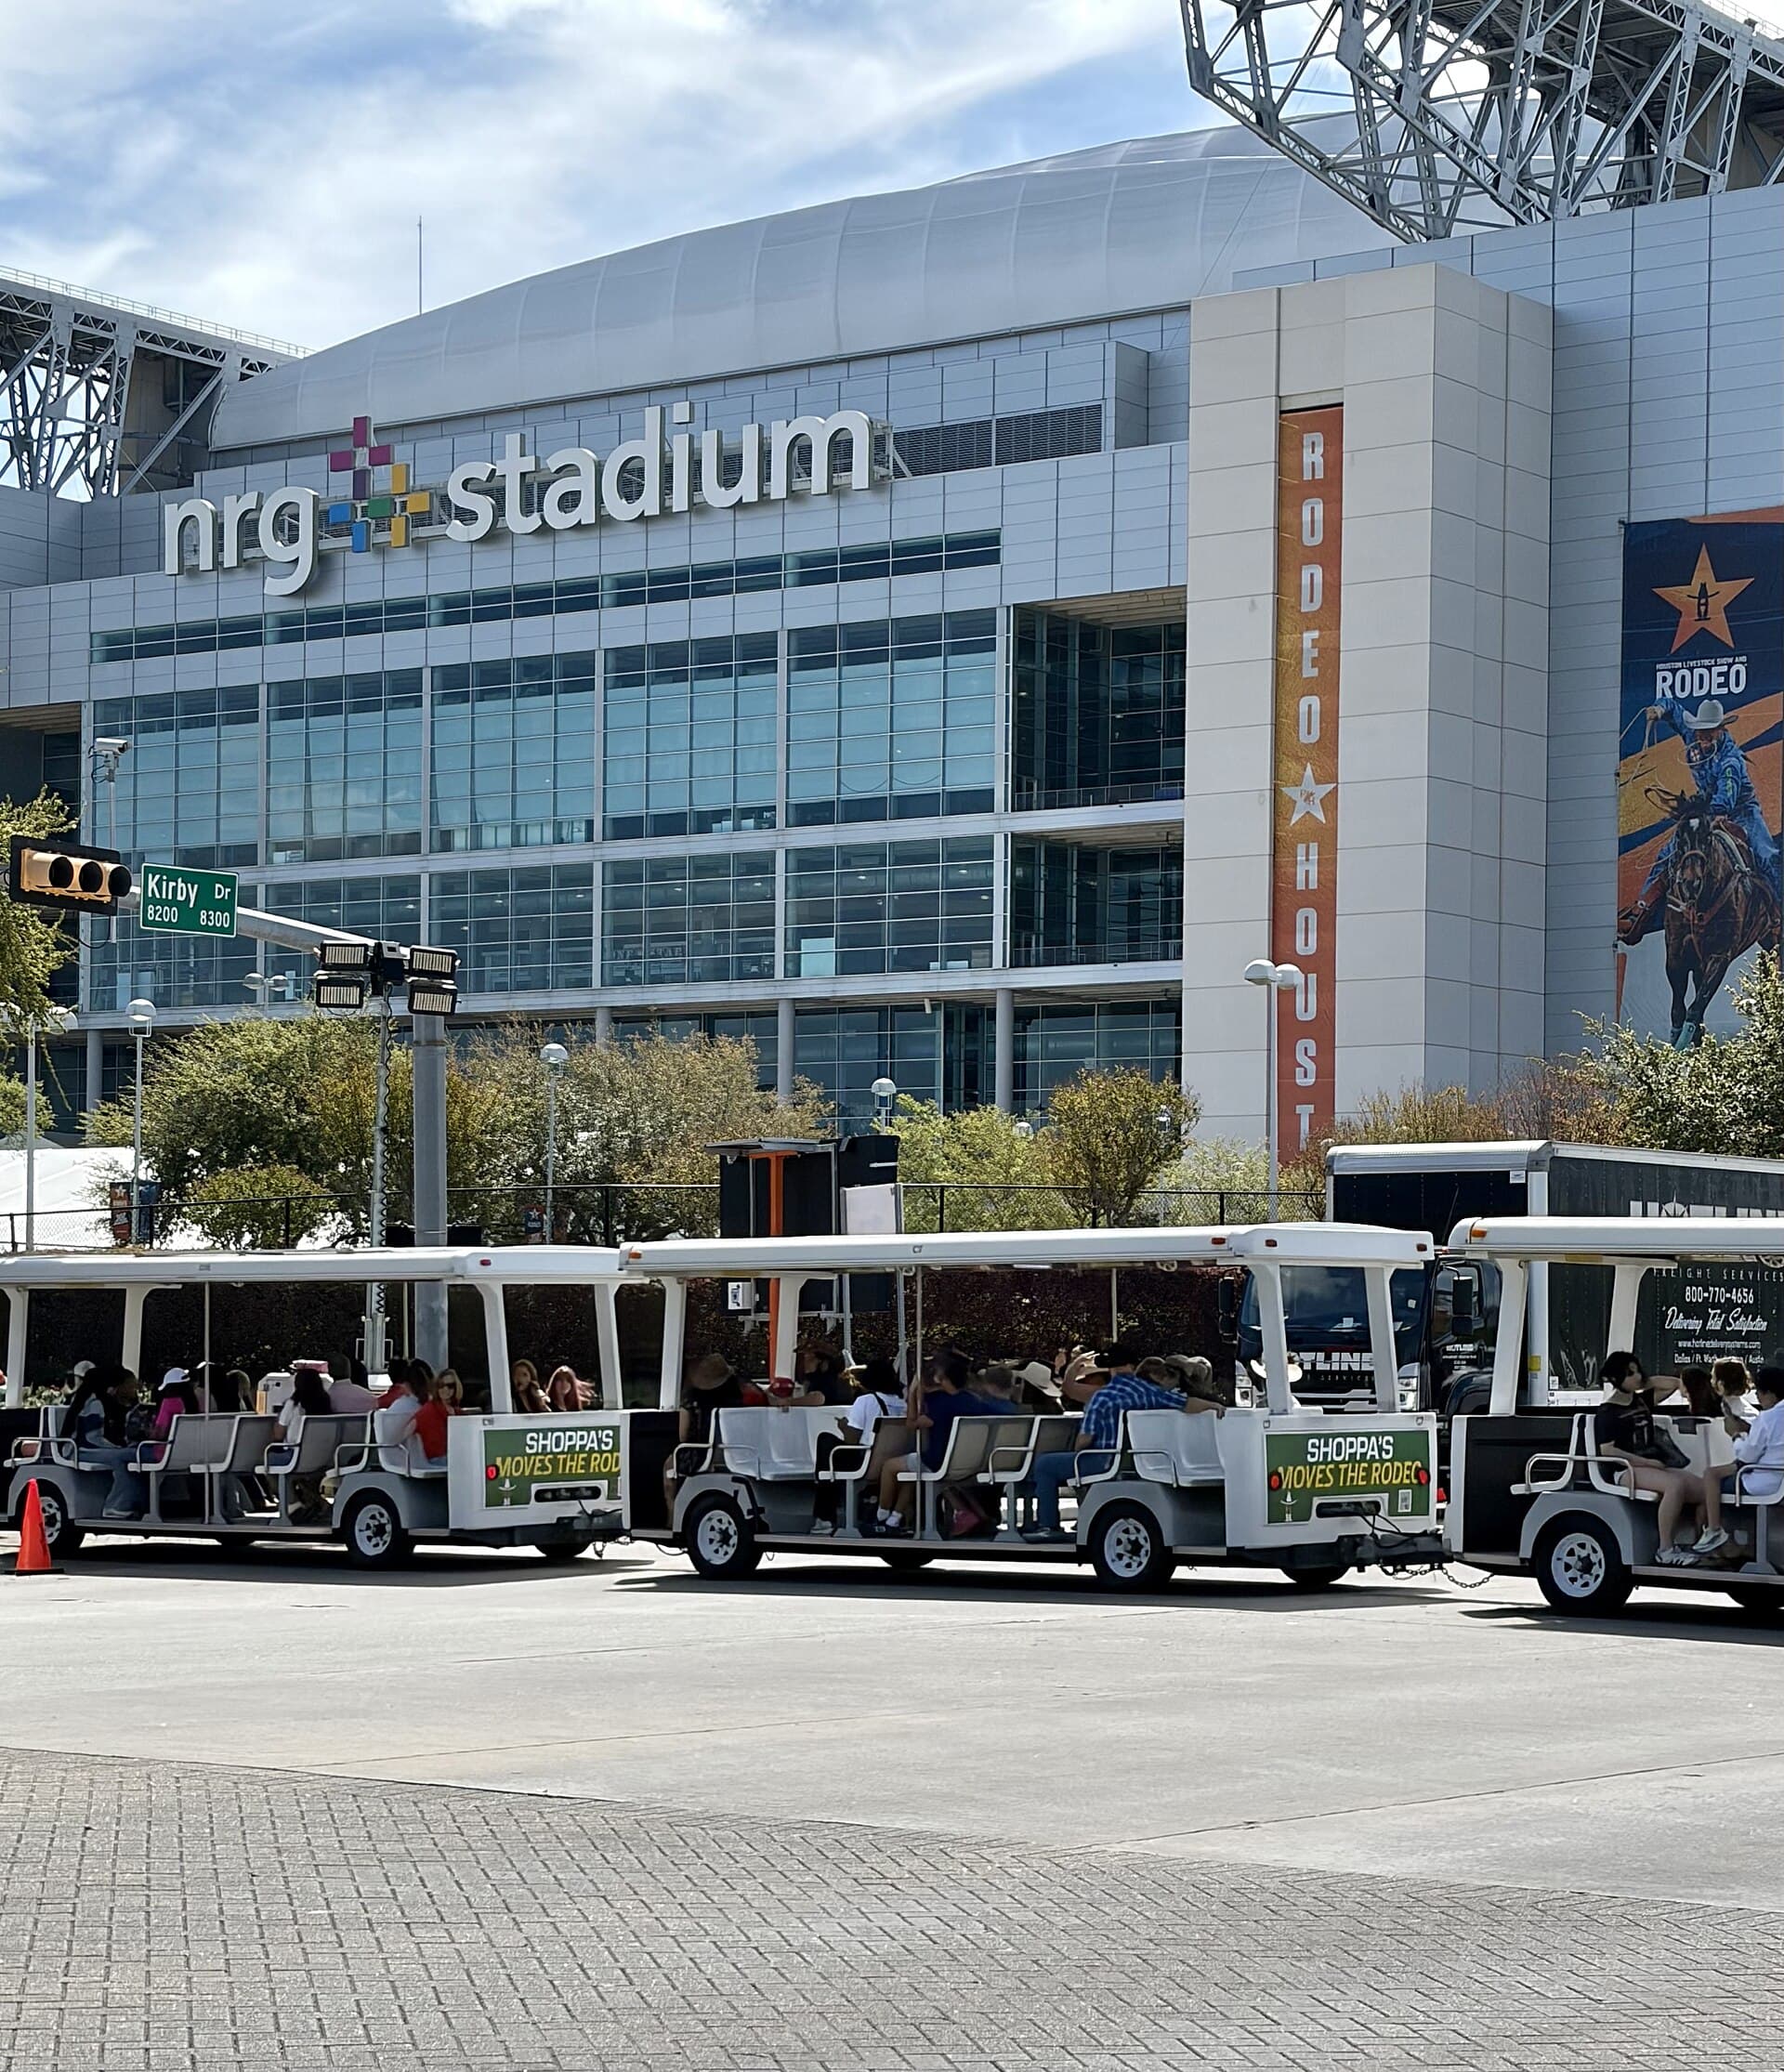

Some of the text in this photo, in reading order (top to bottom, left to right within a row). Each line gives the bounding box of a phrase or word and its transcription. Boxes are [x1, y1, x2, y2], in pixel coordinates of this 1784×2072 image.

[164, 400, 875, 596] nrg stadium
[1298, 431, 1324, 744] RODEO
[1683, 658, 1715, 668] LIVESTOCK
[1716, 657, 1734, 665] SHOW
[1656, 665, 1747, 699] RODEO
[148, 873, 230, 908] Kirby Dr
[148, 905, 230, 927] 8200 8300
[1723, 1269, 1784, 1282] SERVICES
[1685, 1286, 1754, 1304] 800-770-4656
[525, 1430, 613, 1453] SHOPPA'S
[1306, 1436, 1394, 1462] SHOPPA'S
[496, 1454, 553, 1477] MOVES
[558, 1453, 587, 1475] THE
[1278, 1464, 1334, 1489] MOVES
[1338, 1462, 1367, 1487] THE
